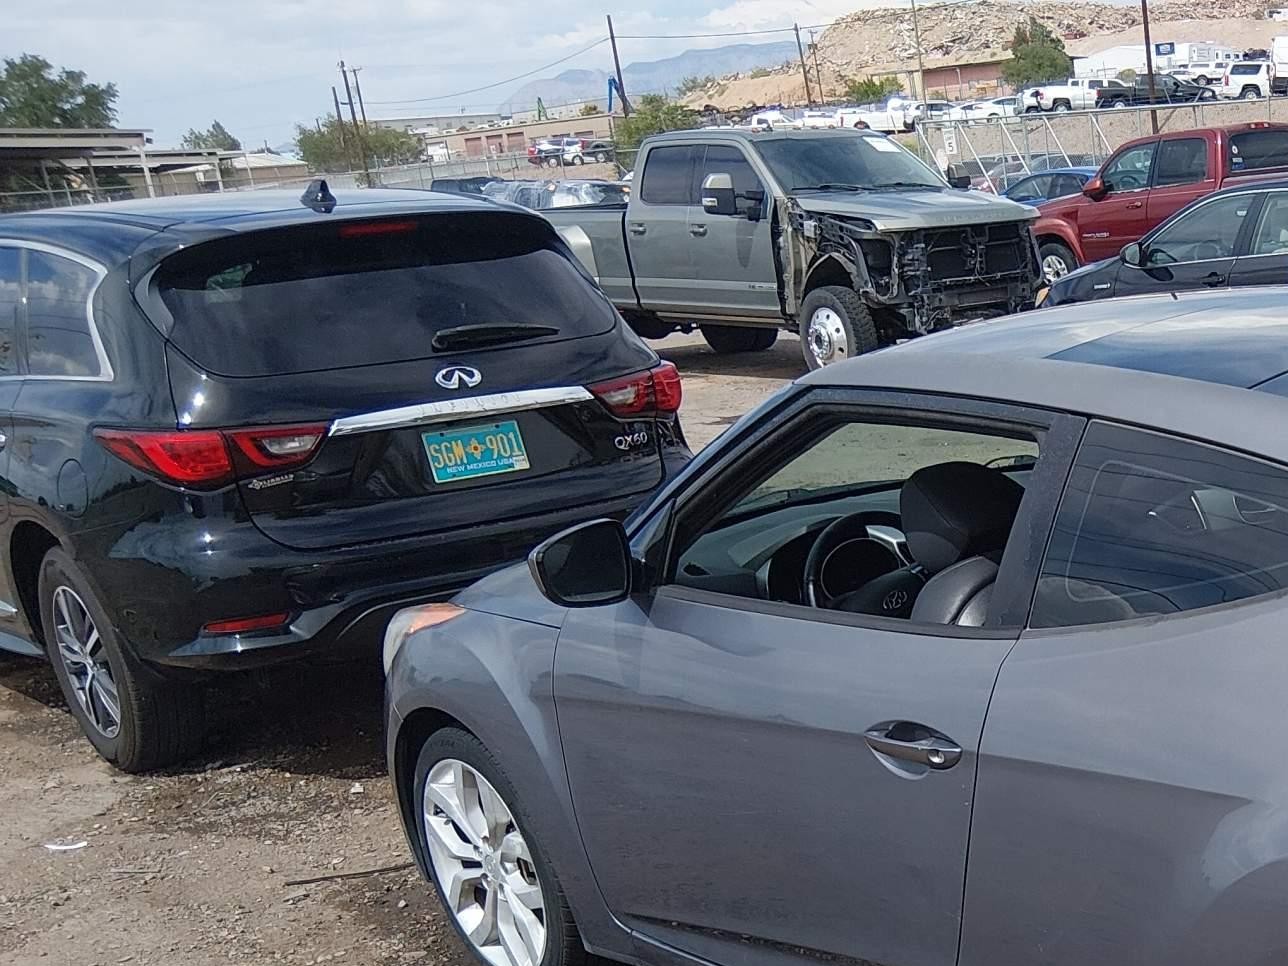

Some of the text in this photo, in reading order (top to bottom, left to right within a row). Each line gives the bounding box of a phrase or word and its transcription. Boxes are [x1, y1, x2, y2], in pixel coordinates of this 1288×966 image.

[429, 431, 522, 469] SGM 901
[614, 431, 648, 450] QX60
[446, 464, 466, 473] NEW
[466, 460, 497, 471] MEXICO
